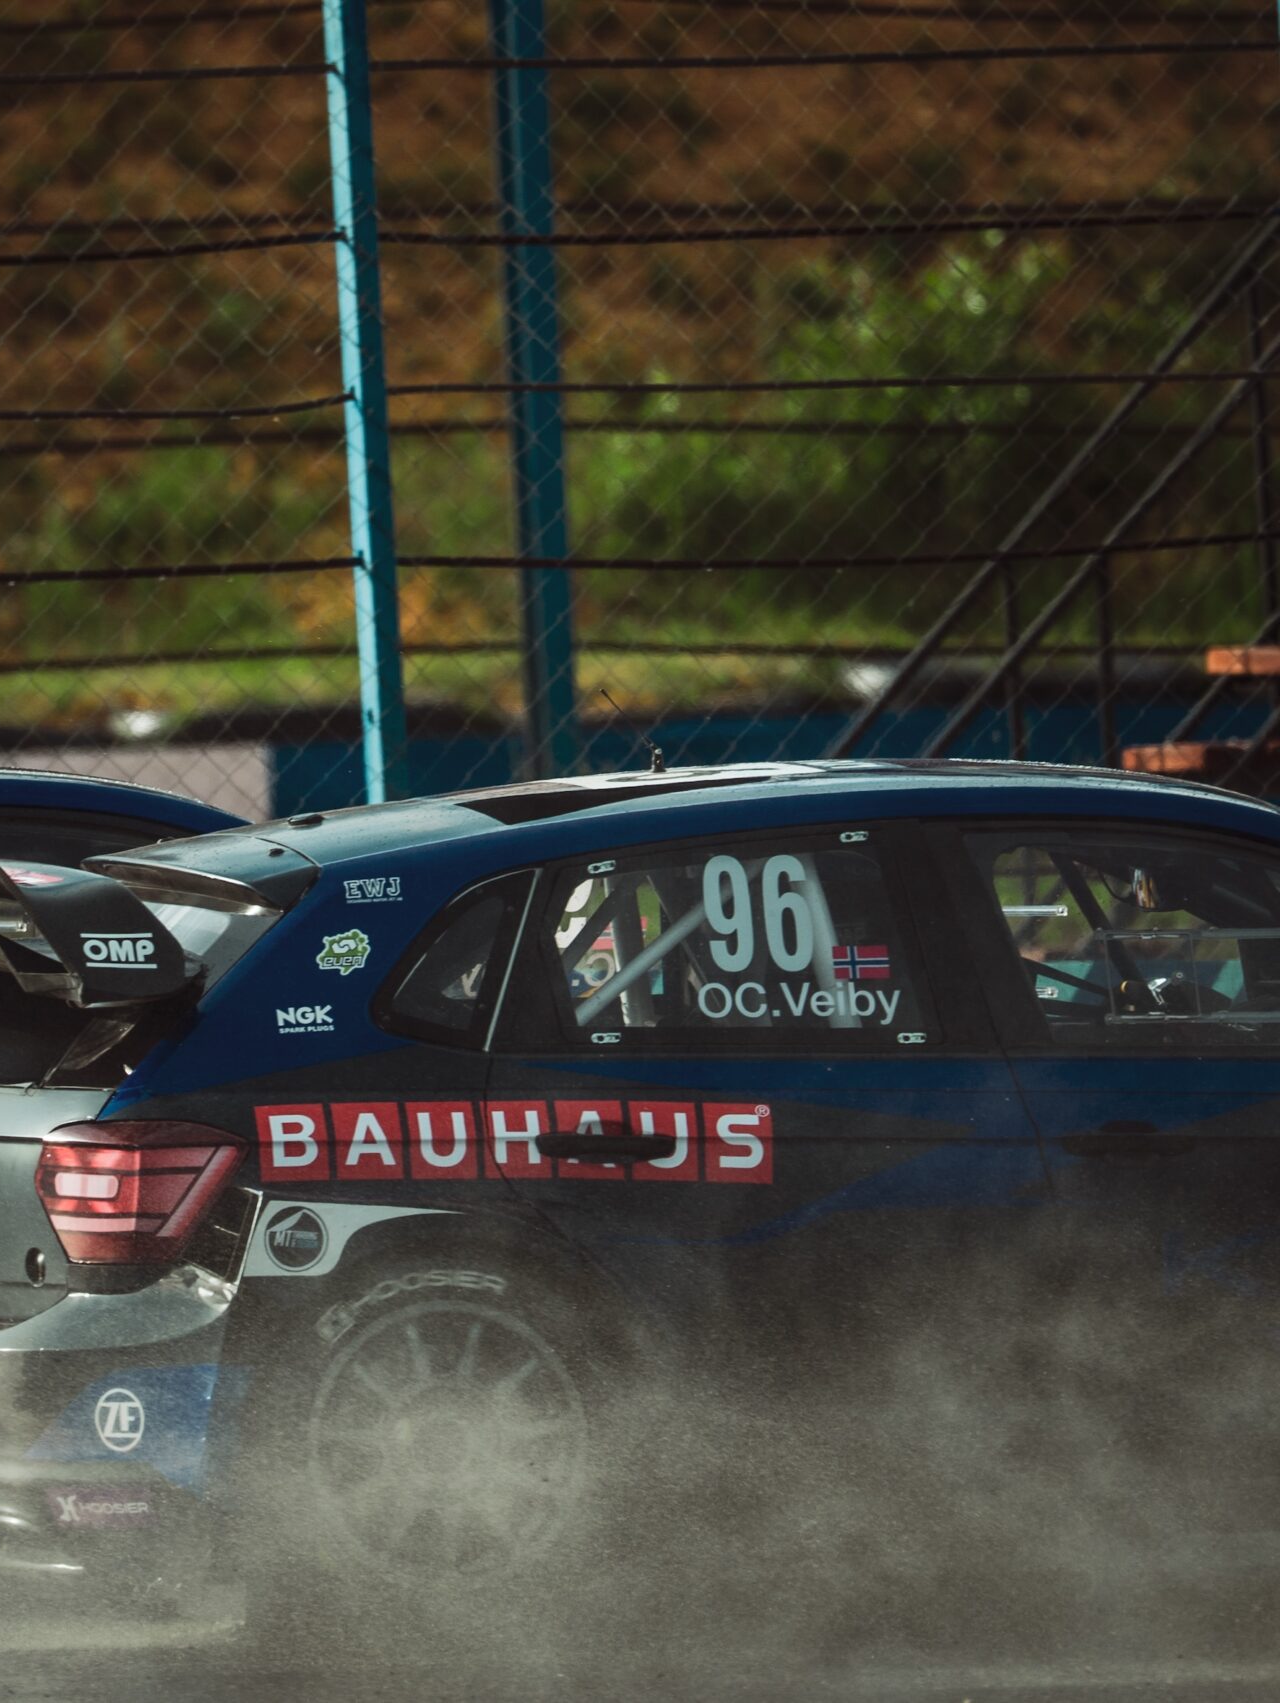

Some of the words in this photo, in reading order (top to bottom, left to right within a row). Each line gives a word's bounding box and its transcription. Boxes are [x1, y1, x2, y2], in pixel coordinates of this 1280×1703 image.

[343, 876, 401, 899] EWJ
[702, 854, 814, 973] 96
[83, 939, 155, 963] OMP
[276, 1004, 334, 1026] NGK
[697, 982, 901, 1026] OC.Veiby
[278, 1026, 305, 1034] SPARK
[306, 1024, 335, 1032] PLUGS
[99, 1401, 141, 1439] ZF
[78, 1502, 150, 1515] HOOSIER
